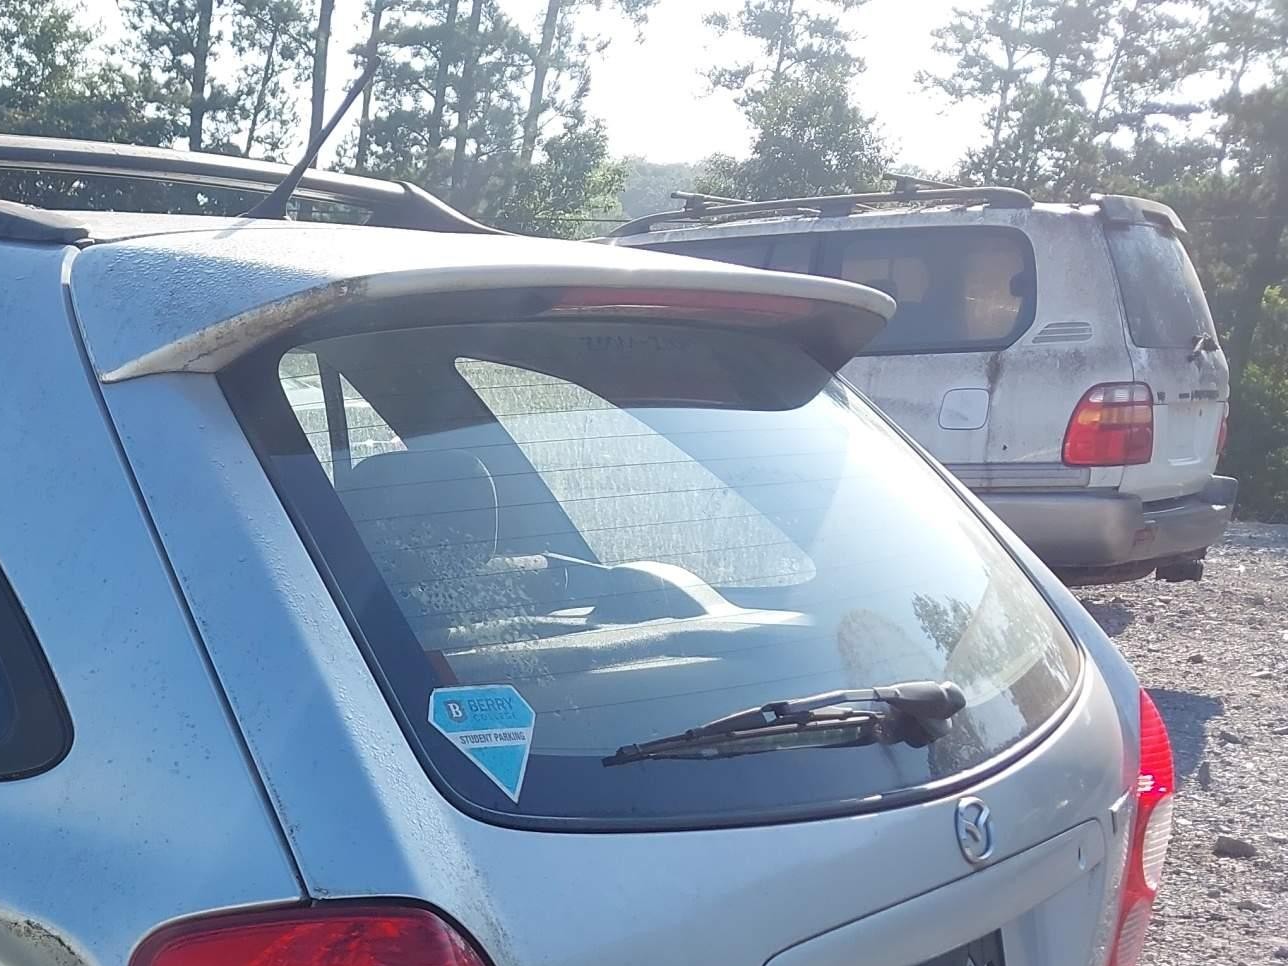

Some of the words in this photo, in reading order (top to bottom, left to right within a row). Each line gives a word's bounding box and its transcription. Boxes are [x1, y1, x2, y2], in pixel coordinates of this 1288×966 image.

[448, 703, 463, 718] B
[468, 698, 513, 712] BERRY
[459, 733, 492, 744] STUDENT
[493, 731, 526, 742] PARKING
